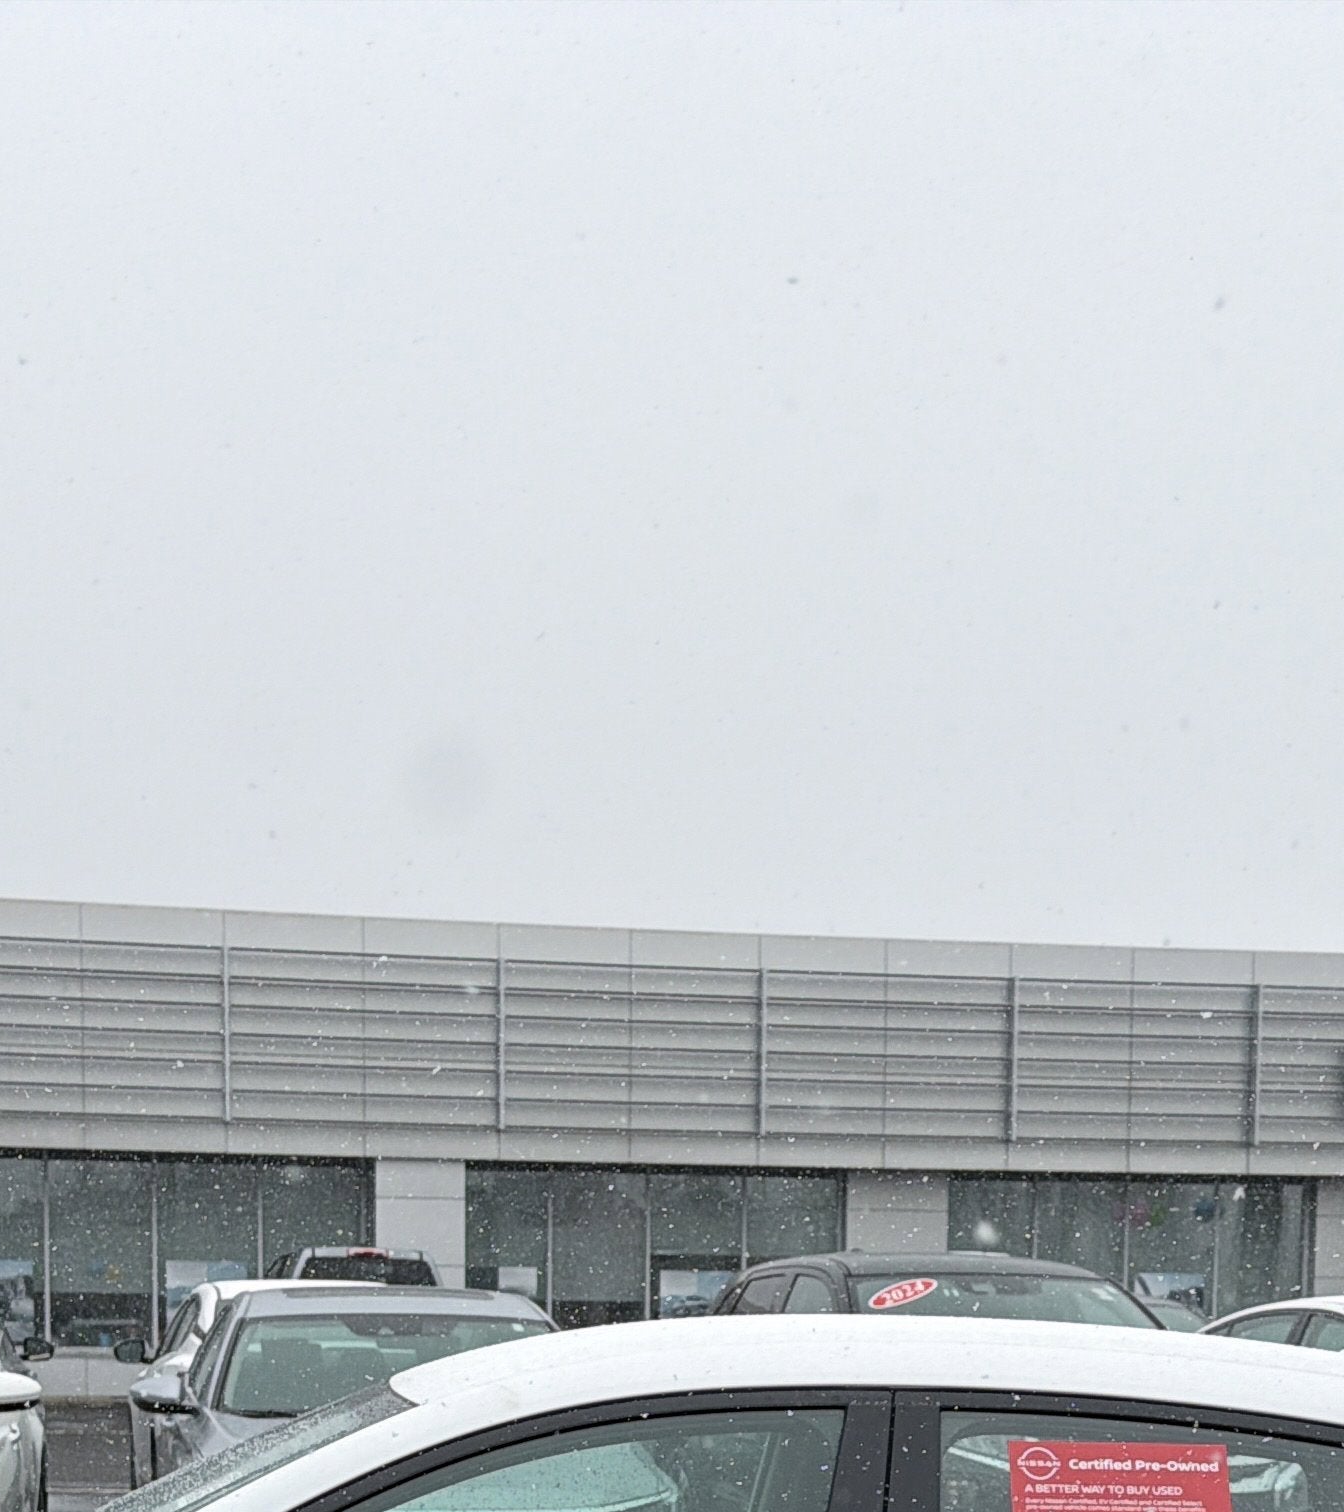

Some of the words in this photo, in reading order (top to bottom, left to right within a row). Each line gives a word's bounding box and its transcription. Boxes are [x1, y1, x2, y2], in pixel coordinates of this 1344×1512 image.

[1068, 1458, 1132, 1471] Certified
[1135, 1459, 1219, 1472] Pre-Owned
[1024, 1484, 1034, 1493] A
[1035, 1484, 1080, 1493] BETTER
[1080, 1485, 1105, 1494] WAY
[1107, 1485, 1124, 1494] TO
[1126, 1485, 1150, 1495] BUY
[1151, 1486, 1183, 1495] USED
